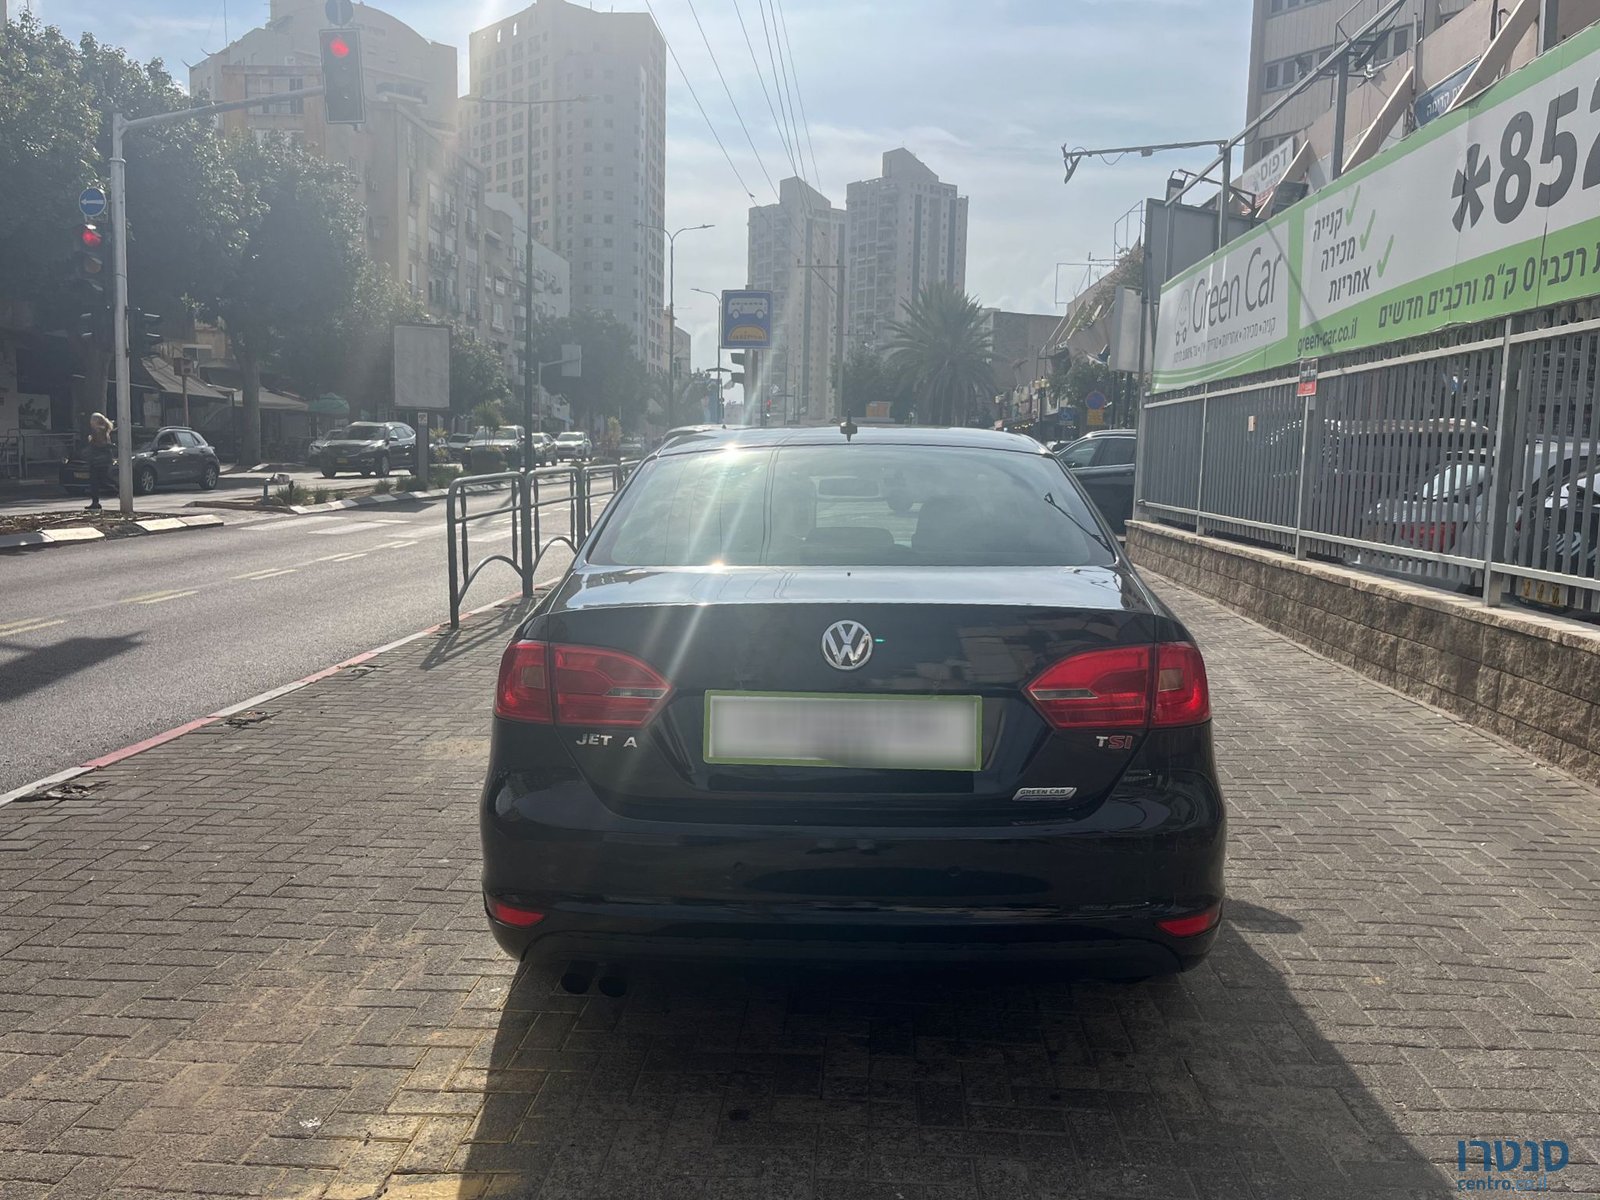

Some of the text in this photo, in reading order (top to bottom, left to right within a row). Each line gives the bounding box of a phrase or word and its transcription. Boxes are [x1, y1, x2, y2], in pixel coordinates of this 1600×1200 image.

[1261, 147, 1287, 181] דפוס
[1313, 208, 1343, 242] קנייה
[1321, 236, 1356, 272] מכירה
[1542, 247, 1587, 286] רכבי
[1193, 247, 1282, 333] Green Car
[1328, 265, 1371, 303] אחריות
[1427, 278, 1478, 316] ורכבים
[1378, 295, 1423, 328] חדשים
[1297, 316, 1358, 357] green-car.co.il
[1096, 735, 1133, 749] TSI
